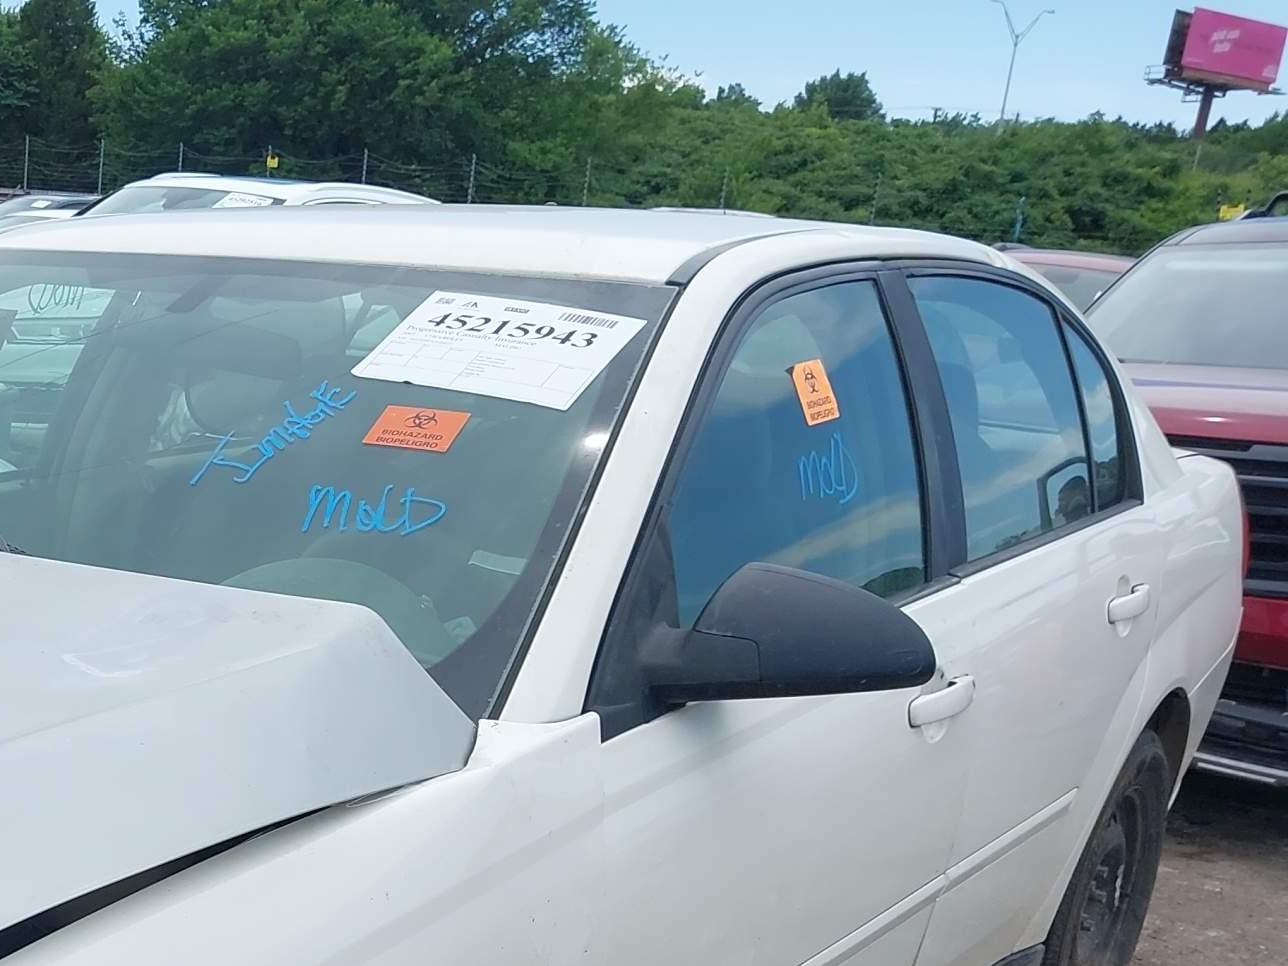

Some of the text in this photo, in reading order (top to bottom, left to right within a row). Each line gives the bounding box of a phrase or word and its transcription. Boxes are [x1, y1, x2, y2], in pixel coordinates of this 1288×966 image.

[427, 312, 599, 349] 45215943
[381, 428, 444, 441] BIOHAZARD
[375, 435, 439, 449] BIOPELIGRO
